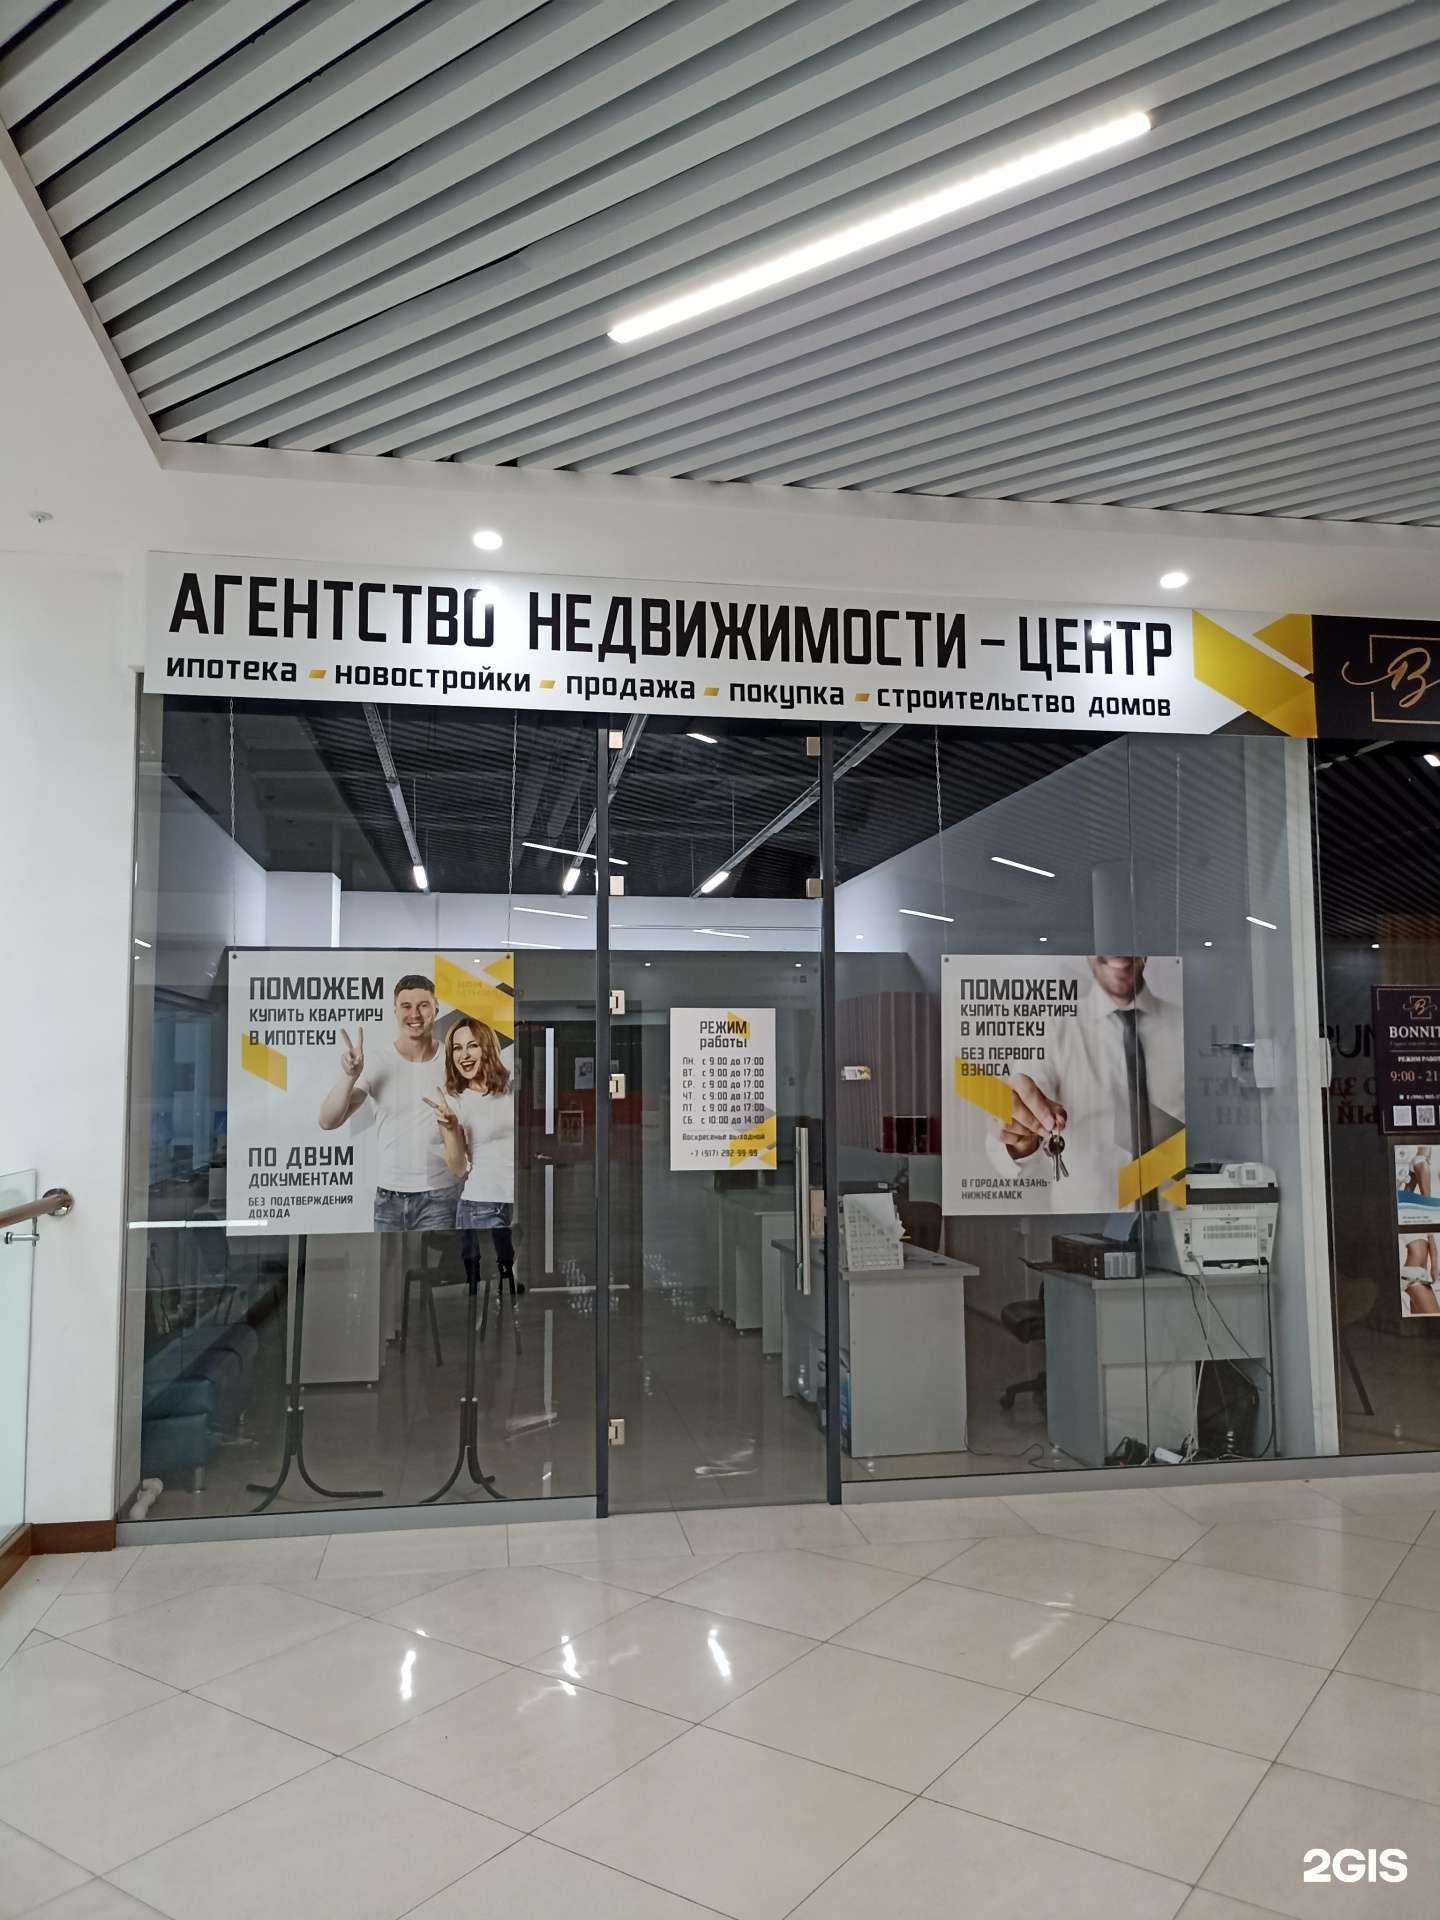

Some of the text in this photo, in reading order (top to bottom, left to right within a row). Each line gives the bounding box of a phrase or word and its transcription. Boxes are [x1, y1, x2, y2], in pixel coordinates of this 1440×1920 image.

[168, 572, 497, 648] АГЕНТСТВО
[529, 591, 966, 669] НЕДВИЖИМОСТИ
[1019, 616, 1173, 681] ЦЕНТР
[166, 657, 1171, 717] ипотека новостройки продажа покупка строительство домов
[249, 976, 384, 1000] ПОМОЖЕМ
[960, 979, 1078, 1001] ПОМОЖЕМ
[249, 1008, 383, 1022] КУПИТЬ КВАРТИРУ
[960, 1004, 1077, 1017] КУПИТЬ КВАРТИРУ
[700, 1021, 747, 1034] РЕЖИМ
[960, 1021, 1045, 1036] В ИПОТЕКУ
[249, 1030, 336, 1045] В ИПОТЕКУ
[700, 1035, 747, 1050] работы
[961, 1047, 1045, 1060] БЕЗ ПЕРВОГО
[730, 1058, 741, 1067] до
[730, 1070, 741, 1078] до
[961, 1063, 1011, 1076] ВЗНОСА
[1390, 1070, 1416, 1082] 9:00
[730, 1081, 741, 1090] до
[730, 1093, 741, 1102] до
[730, 1105, 741, 1113] до
[731, 1117, 742, 1125] до
[248, 1146, 354, 1169] ПО ДВУМ
[248, 1172, 353, 1189] ДОКУМЕНТАМ
[961, 1178, 967, 1188] В
[970, 1178, 1011, 1188] ГОРОДАХ
[248, 1195, 353, 1207] БЕЗ ПОДТВЕРЖДЕНИЯ
[961, 1191, 1023, 1200] НИЖНЕКАМСК
[248, 1208, 291, 1219] ДОХОДА
